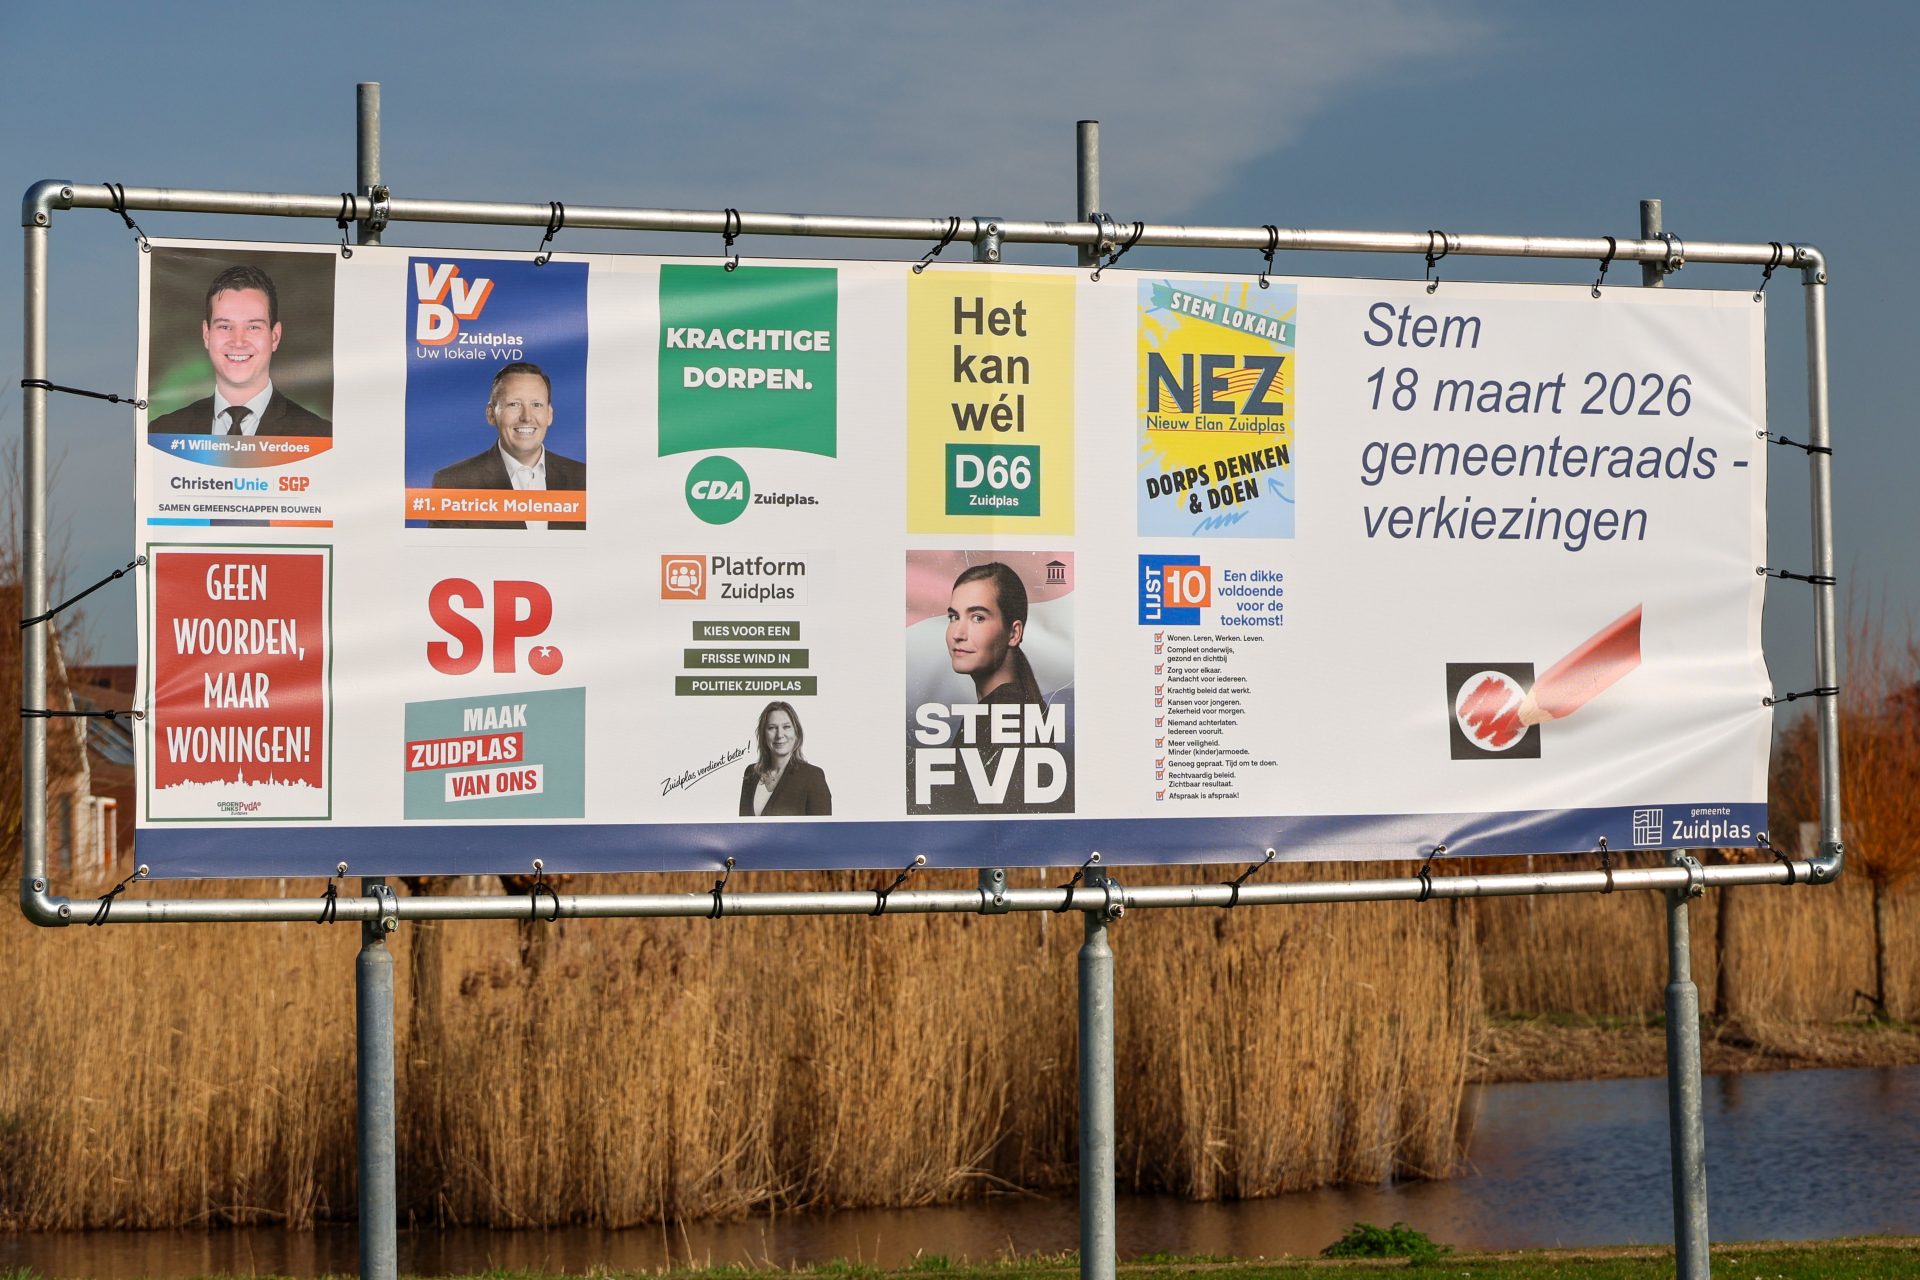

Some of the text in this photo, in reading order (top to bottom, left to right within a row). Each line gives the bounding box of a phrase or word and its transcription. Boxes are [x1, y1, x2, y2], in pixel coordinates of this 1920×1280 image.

[954, 297, 1027, 337] Het
[1171, 292, 1286, 341] STEM LOKAAL
[1363, 302, 1482, 348] Stem
[459, 333, 523, 346] Zuidplas
[667, 328, 830, 351] KRACHTIGE
[416, 347, 522, 360] Uw lokale VVD
[954, 345, 1029, 384] kan
[683, 367, 813, 389] DORPEN.
[1147, 352, 1285, 415] NEZ
[1367, 367, 1693, 416] 18 maart 2026
[951, 393, 1024, 432] wél
[1147, 416, 1285, 435] Nieuw Elan Zuidplas
[171, 440, 310, 452] #1 Willem-Jan Verdoes
[955, 454, 1031, 489] D66
[1146, 444, 1290, 499] DORPS DENKEN
[1361, 435, 1717, 486] gemeenteraads
[170, 476, 310, 491] ChristenUnie SGP
[691, 480, 743, 500] CDA
[413, 498, 579, 513] #1. Patrick Molenaar
[754, 493, 819, 507] Zuidplas.
[969, 495, 1019, 508] Zuidplas
[1189, 478, 1259, 514] & DOEN
[158, 504, 190, 512] SAMEN
[193, 504, 278, 513] GEMEENSCHAPPEN
[1363, 496, 1647, 552] verkiezingen
[712, 556, 805, 575] Platform
[1224, 570, 1283, 582] Een dikke
[206, 564, 266, 600] GEEN
[721, 583, 794, 603] Zuidplas
[1146, 566, 1161, 619] LIJST
[1167, 570, 1206, 603] 10
[1218, 585, 1283, 597] voldoende
[1237, 600, 1283, 611] voor de
[704, 626, 790, 636] KIES VOOR EEN
[1221, 615, 1283, 626] toekomst!
[173, 618, 304, 661] WOORDEN,
[702, 654, 790, 664] FRISSE WIND IN
[204, 672, 269, 708] MAAR
[692, 681, 801, 691] POLITIEK ZUIDPLAS
[1167, 687, 1195, 695] Krachtig
[463, 704, 527, 731] MAAK
[915, 702, 1065, 745] STEM
[167, 726, 310, 763] WONINGEN!
[411, 736, 517, 768] ZUIDPLAS
[1193, 748, 1250, 756] (kinder)armoede.
[661, 740, 751, 796] Zuidplas verdient beter!
[915, 747, 1068, 805] FVD
[452, 770, 536, 797] VAN ONS
[1691, 807, 1730, 817] gemeente
[1672, 820, 1751, 842] Zuidplas
